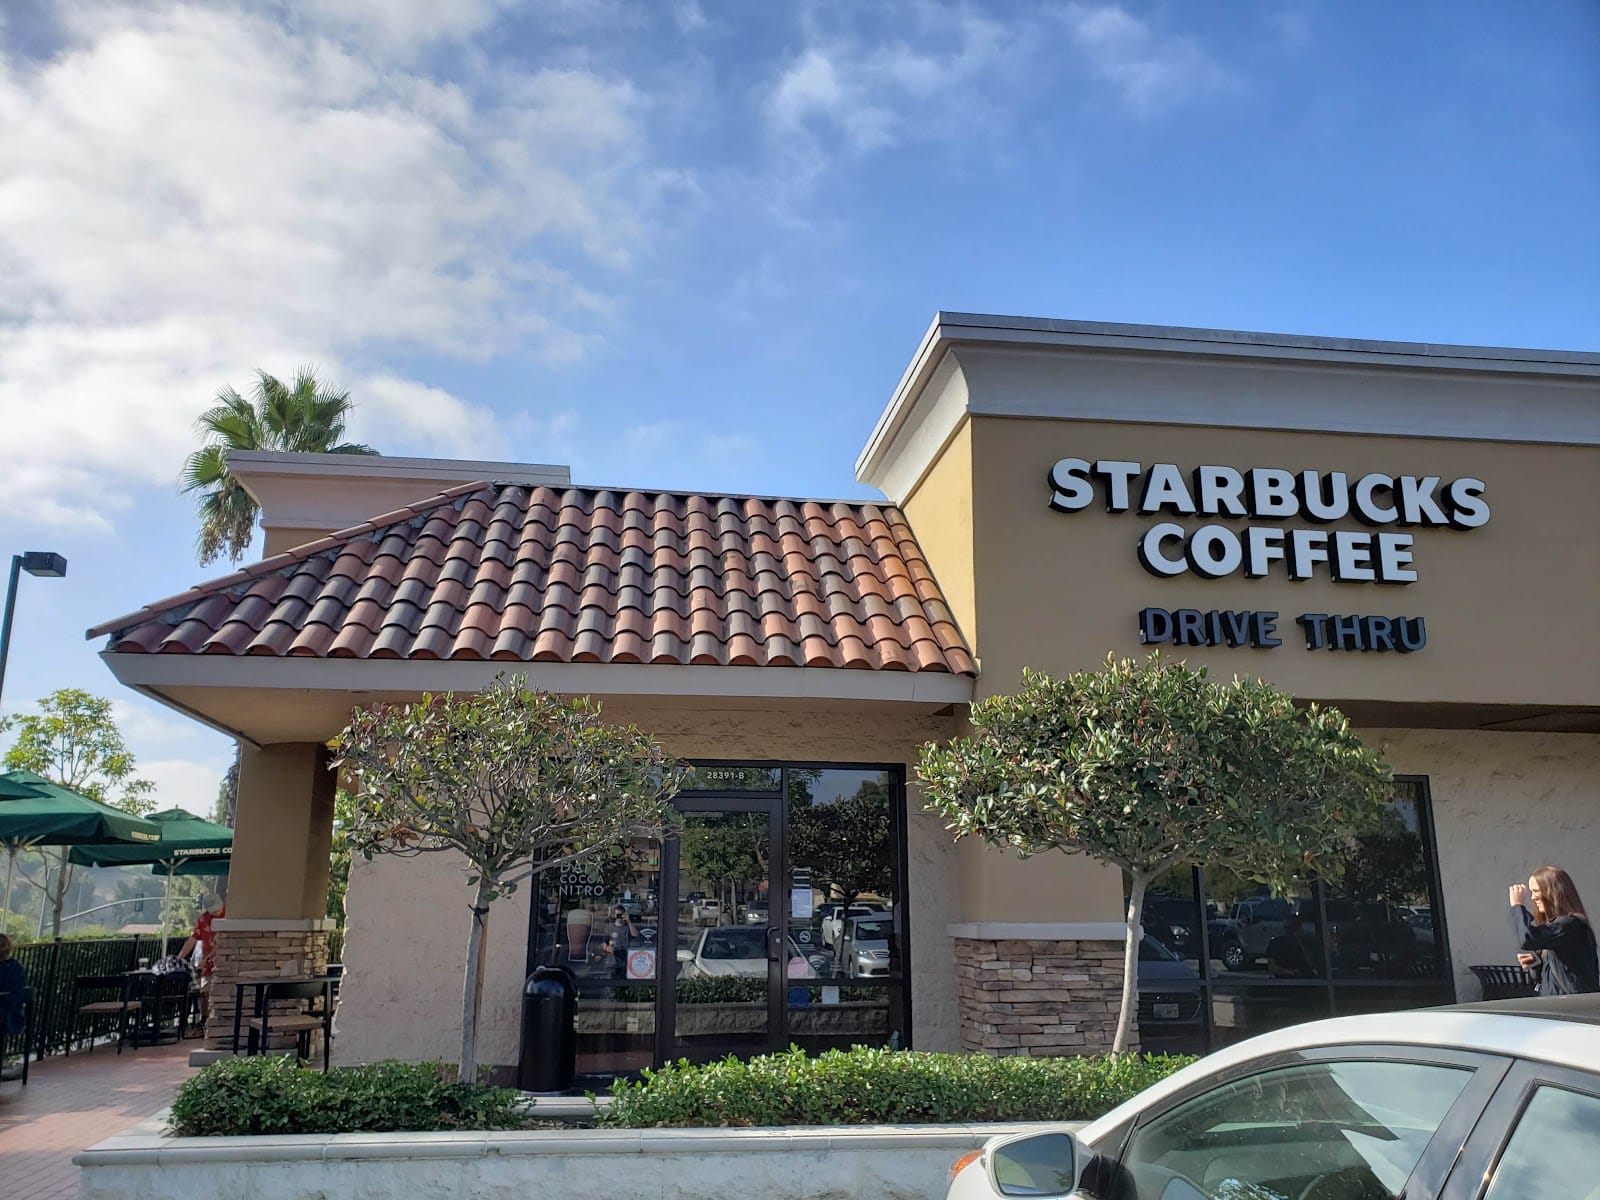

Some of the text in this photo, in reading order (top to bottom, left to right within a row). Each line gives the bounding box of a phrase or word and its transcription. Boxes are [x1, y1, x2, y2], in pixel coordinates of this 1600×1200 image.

[1048, 457, 1491, 531] STARBUCKS
[1137, 522, 1418, 584] COFFEE
[1139, 608, 1427, 653] DRIVE THRU
[706, 771, 745, 780] 28391-B
[173, 848, 220, 856] STARBUCKS
[559, 885, 604, 896] NITRO
